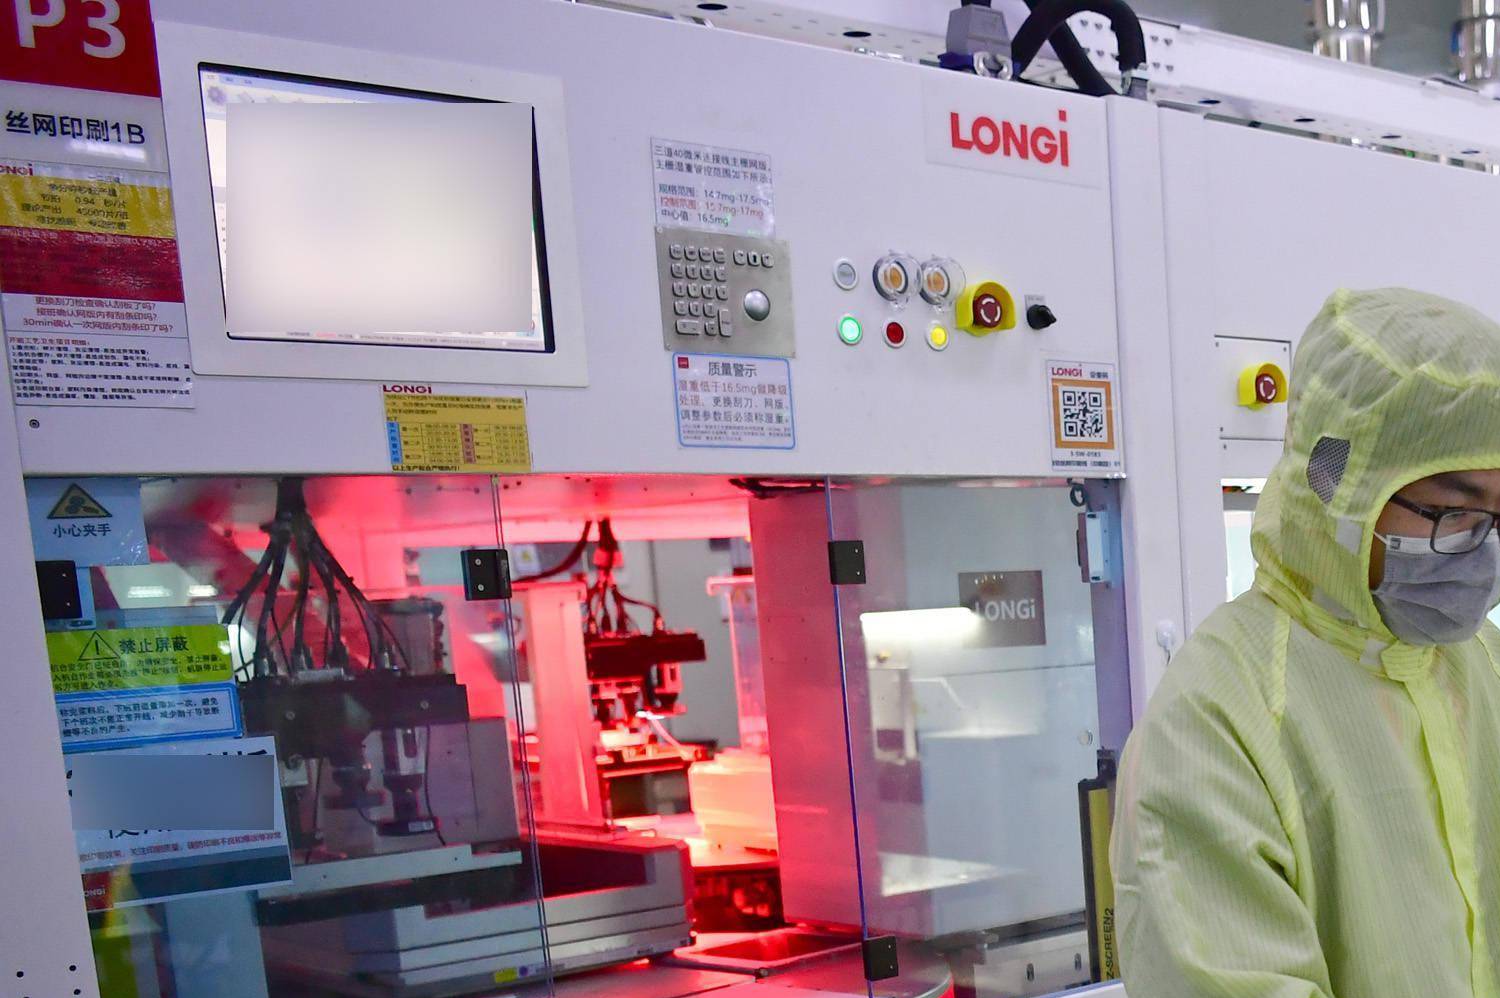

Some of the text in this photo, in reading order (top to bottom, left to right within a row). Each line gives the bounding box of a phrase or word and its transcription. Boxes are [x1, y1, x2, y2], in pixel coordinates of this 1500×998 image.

[14, 0, 126, 59] P3
[6, 110, 145, 145] 丝网印刷1B
[708, 361, 757, 378] 质量警示
[52, 523, 112, 538] 小心夹手
[119, 635, 189, 654] 禁止屏蔽
